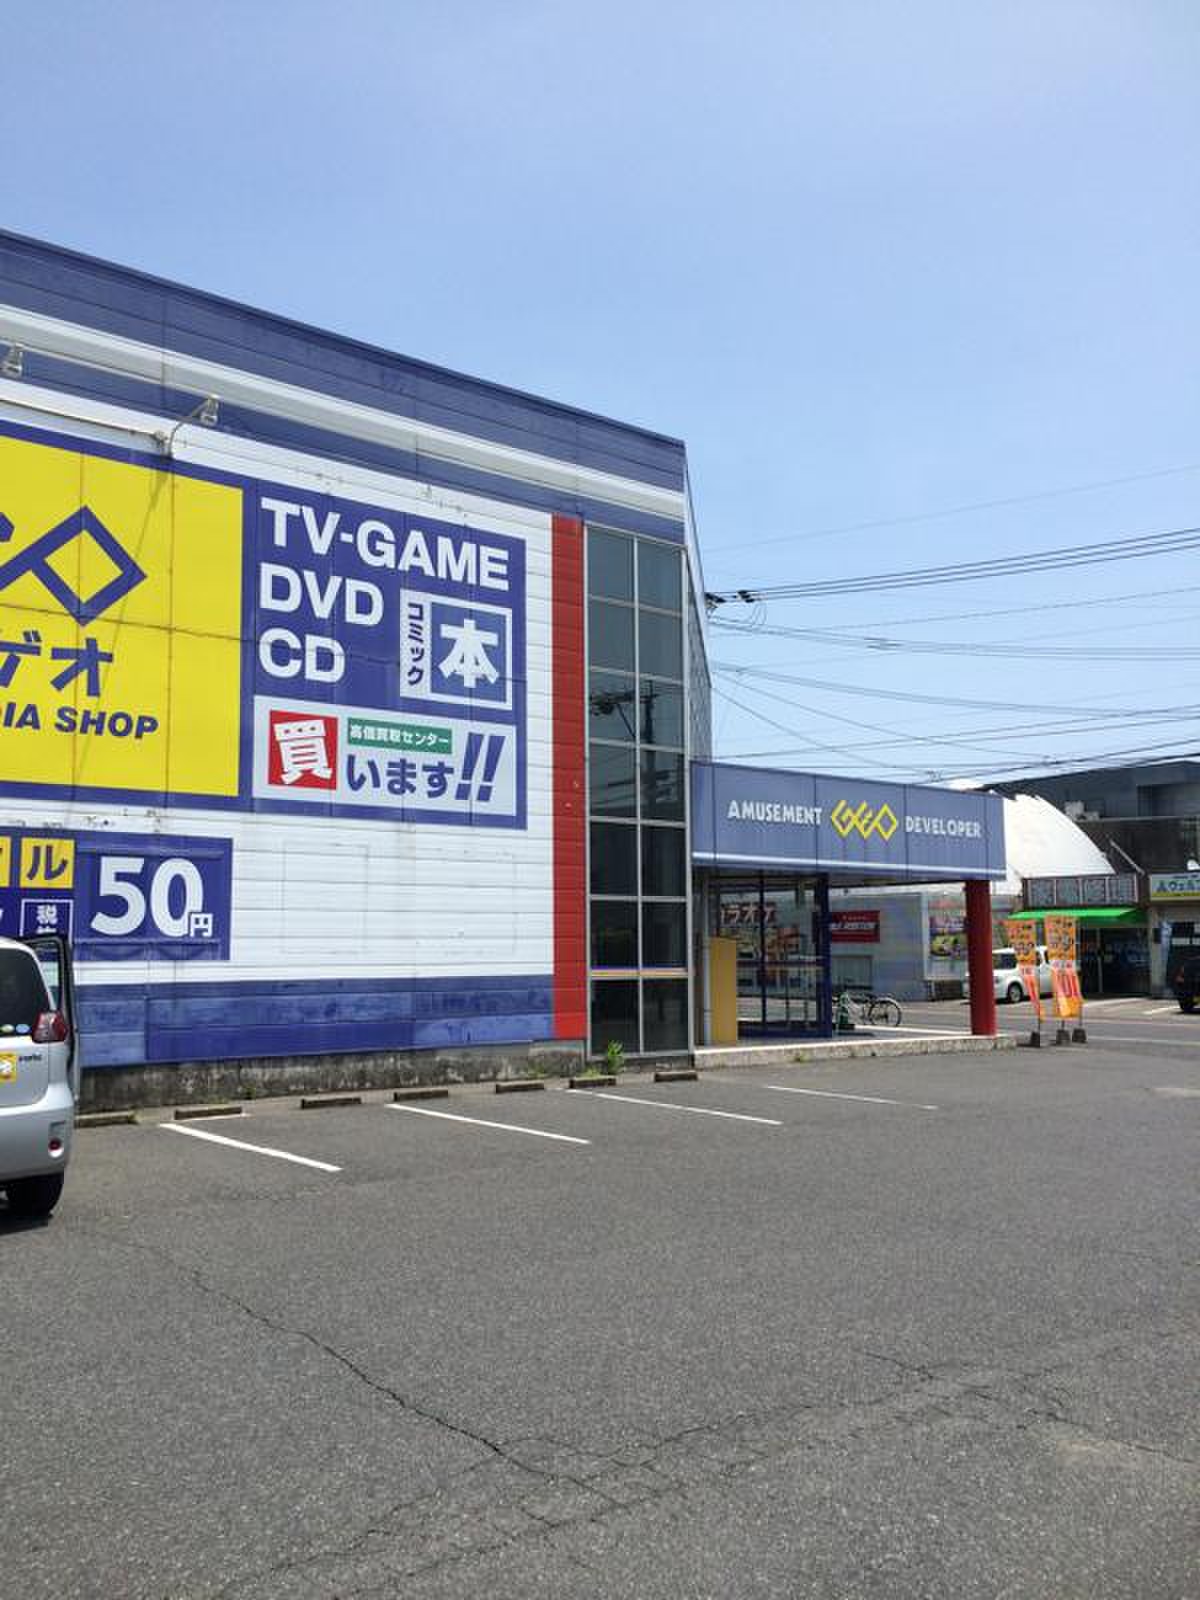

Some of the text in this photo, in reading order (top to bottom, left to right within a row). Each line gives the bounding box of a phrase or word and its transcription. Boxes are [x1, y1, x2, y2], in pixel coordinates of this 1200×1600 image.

[261, 497, 509, 591] TV-GAME
[260, 563, 384, 626] DVD
[259, 629, 346, 684] CD
[408, 602, 424, 685] コミック
[438, 618, 499, 688] 本
[54, 705, 159, 739] SHOP
[727, 800, 981, 841] AMUSEMENT GEO DEVELOPER
